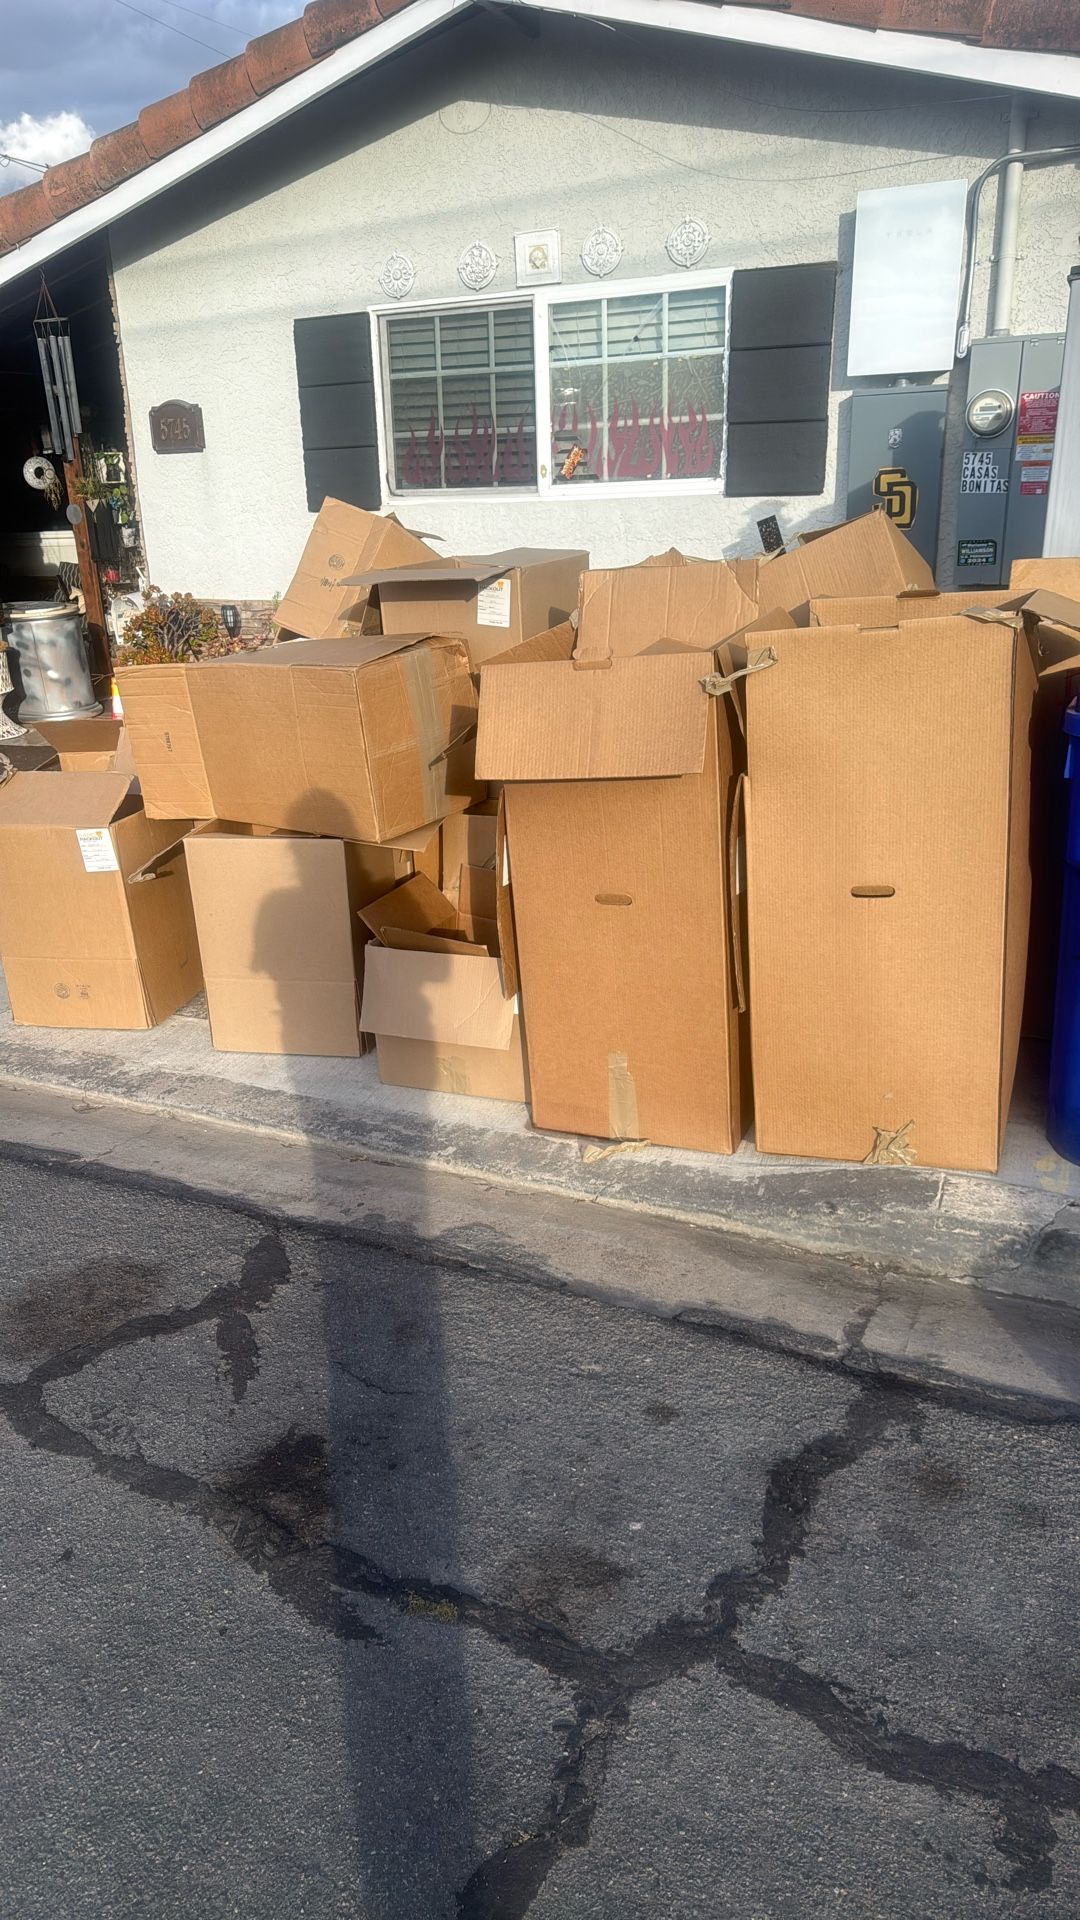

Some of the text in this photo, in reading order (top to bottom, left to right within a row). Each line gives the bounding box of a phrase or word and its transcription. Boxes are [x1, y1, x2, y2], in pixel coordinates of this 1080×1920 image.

[160, 418, 190, 440] 5745
[964, 453, 991, 465] 5745
[963, 466, 997, 479] CASAS
[961, 480, 1009, 492] BONITAS
